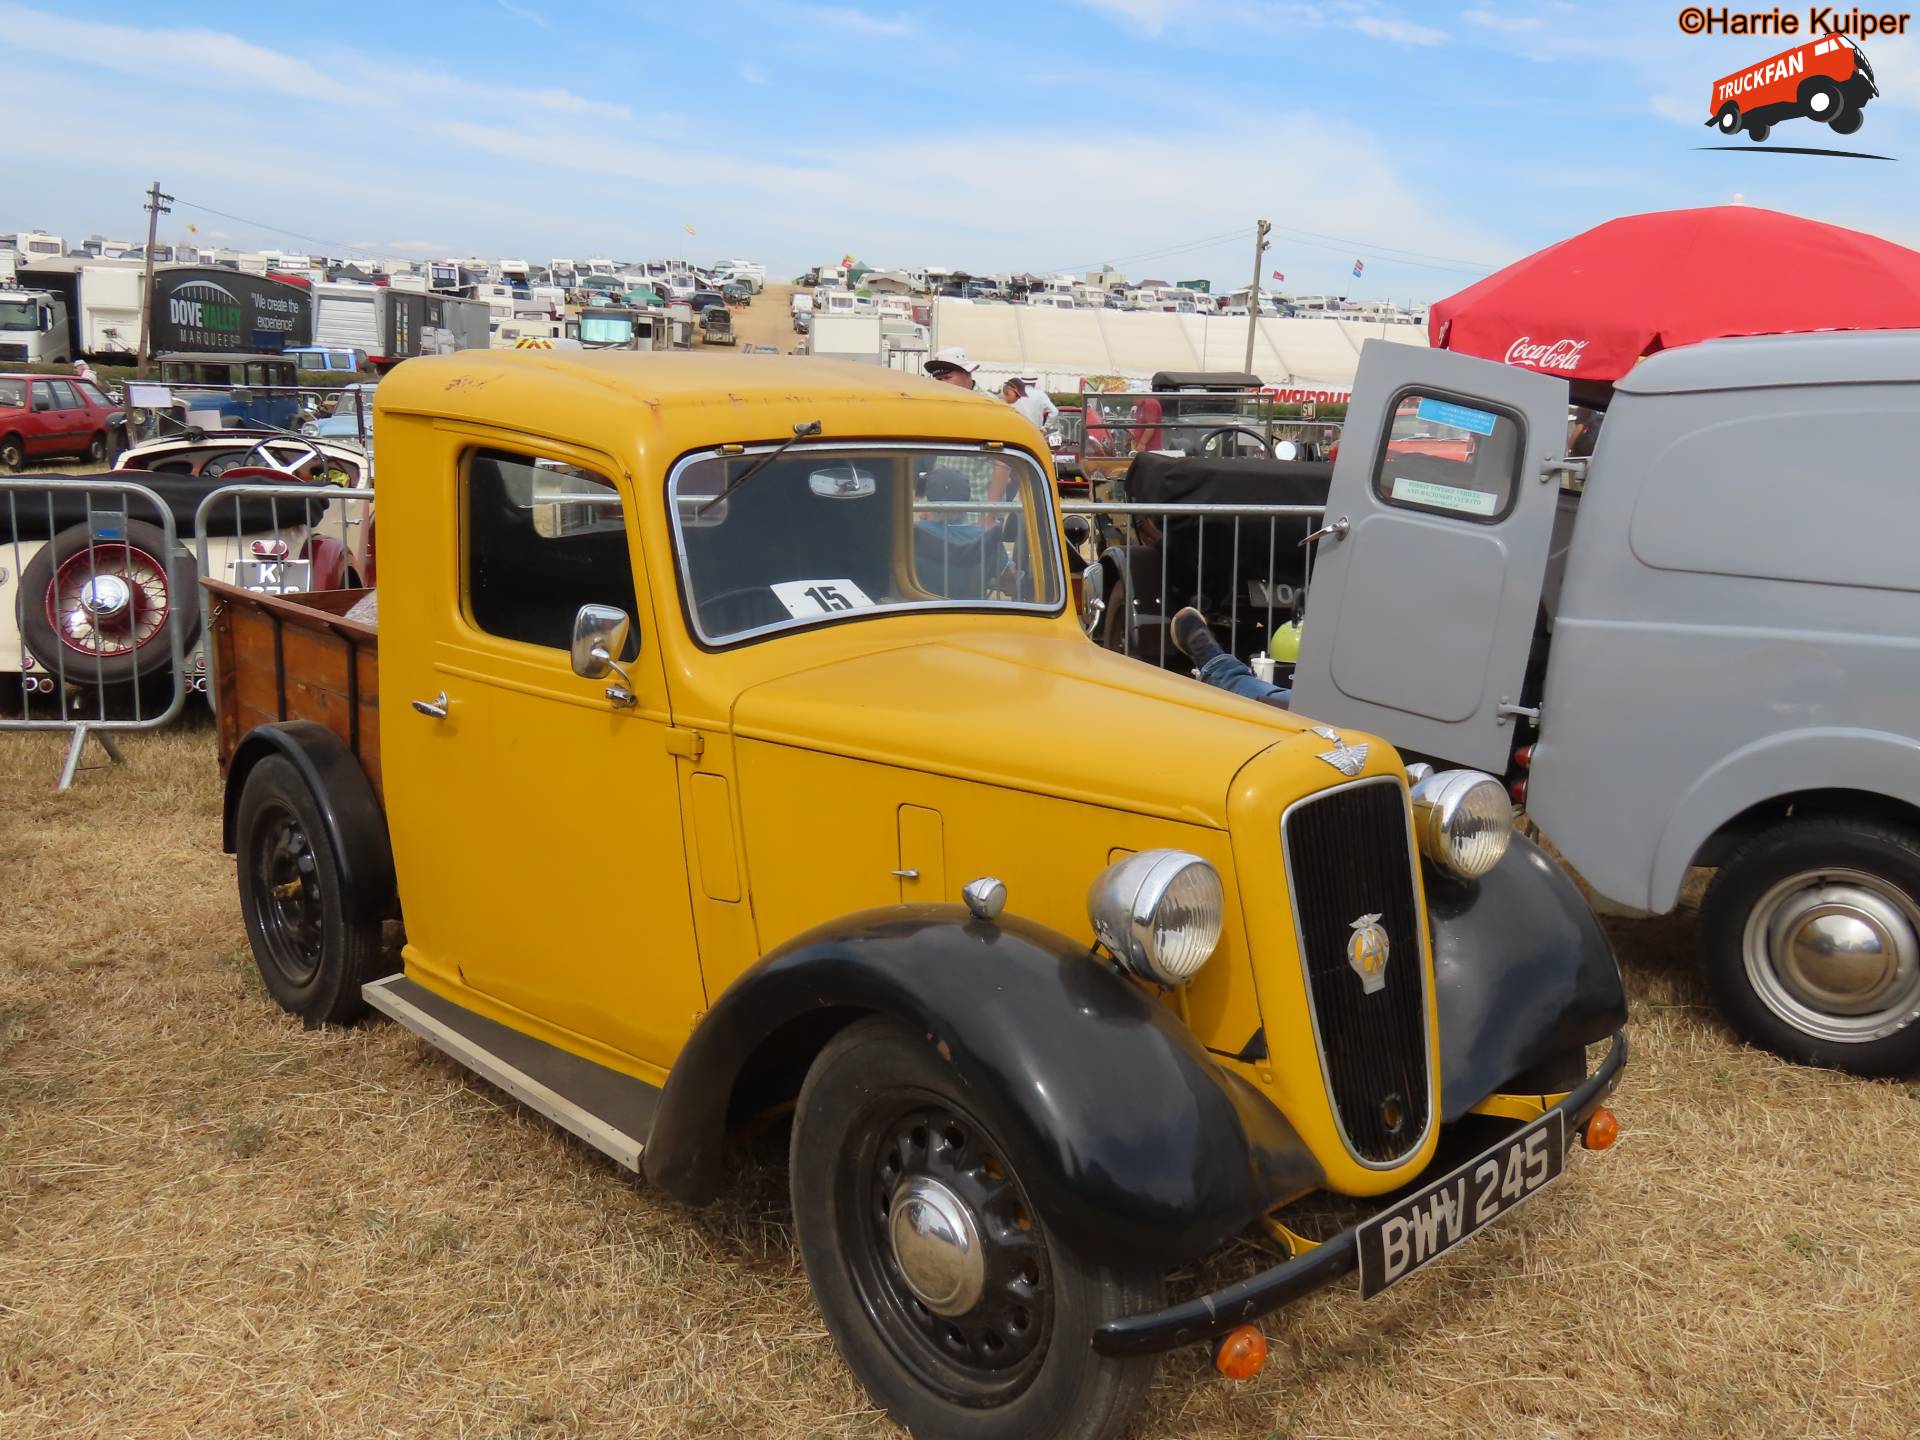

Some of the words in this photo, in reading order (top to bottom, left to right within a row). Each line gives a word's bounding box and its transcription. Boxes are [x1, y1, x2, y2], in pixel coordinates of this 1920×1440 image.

[267, 298, 287, 313] create
[288, 300, 299, 315] the
[1504, 336, 1590, 370] Coca-Cola
[804, 586, 854, 613] 15
[1381, 1177, 1465, 1283] BWV
[1475, 1127, 1548, 1225] 245
